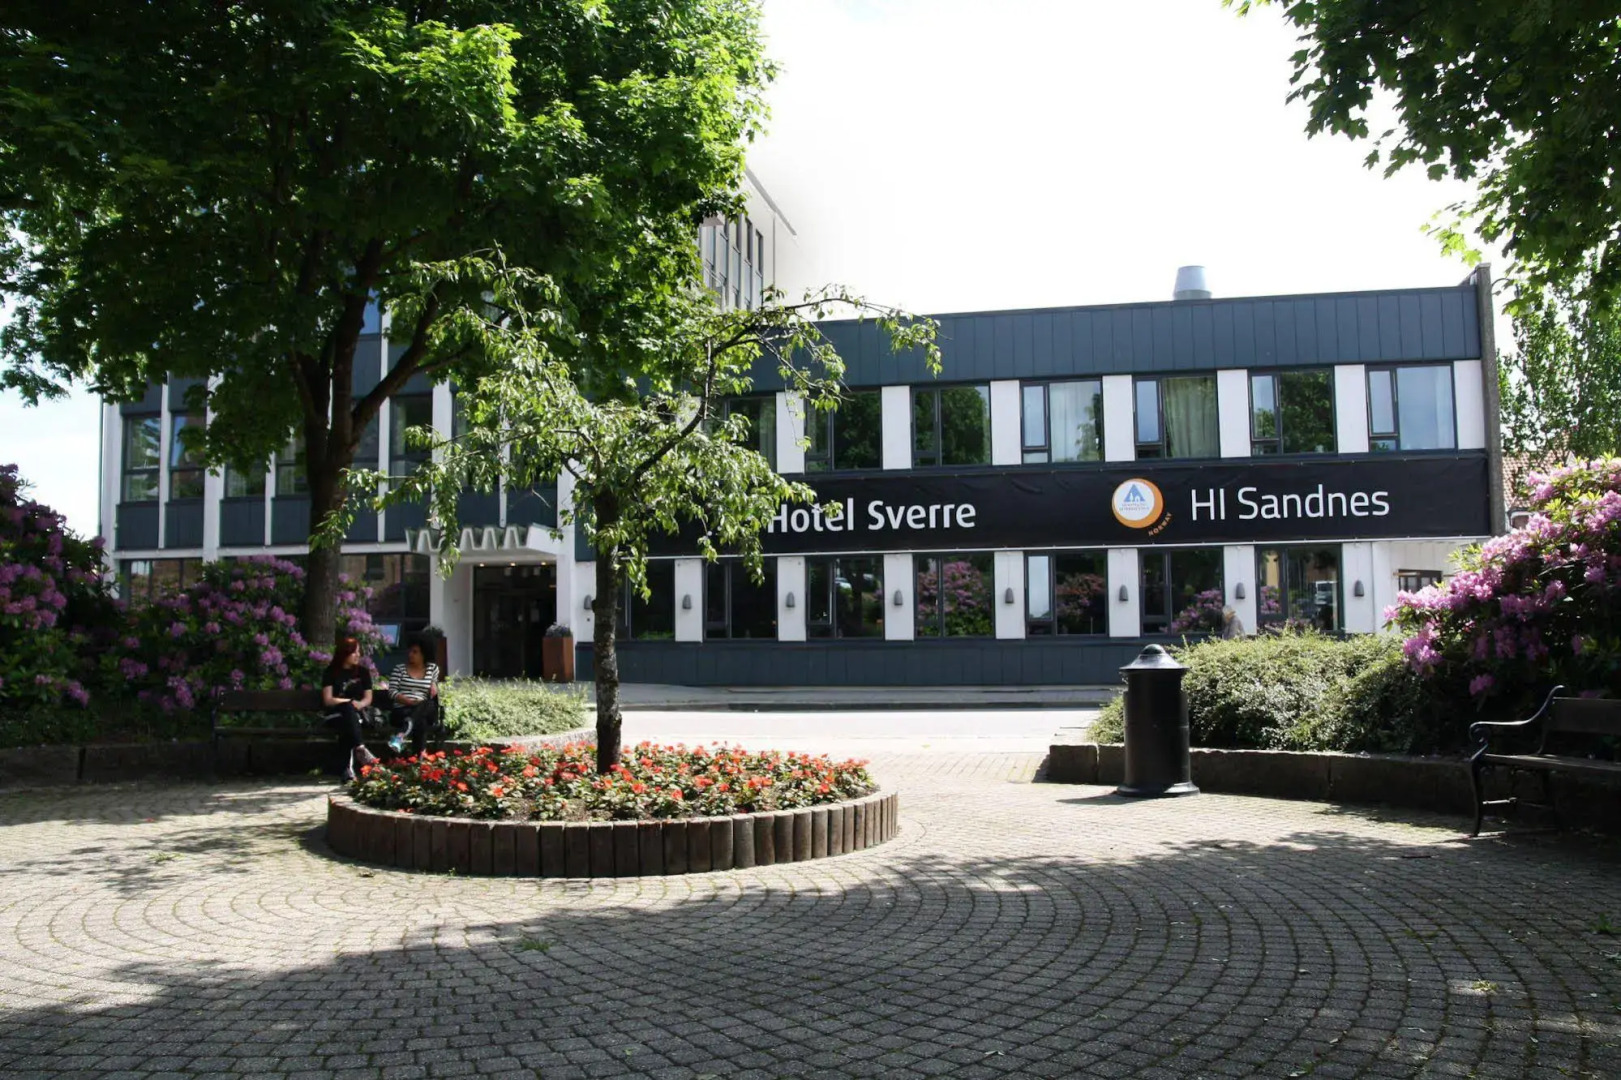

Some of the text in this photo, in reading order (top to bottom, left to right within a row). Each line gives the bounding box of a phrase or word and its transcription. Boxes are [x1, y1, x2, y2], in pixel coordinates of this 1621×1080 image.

[767, 498, 977, 533] Hotel Sverre
[1191, 484, 1390, 521] HI Sandnes
